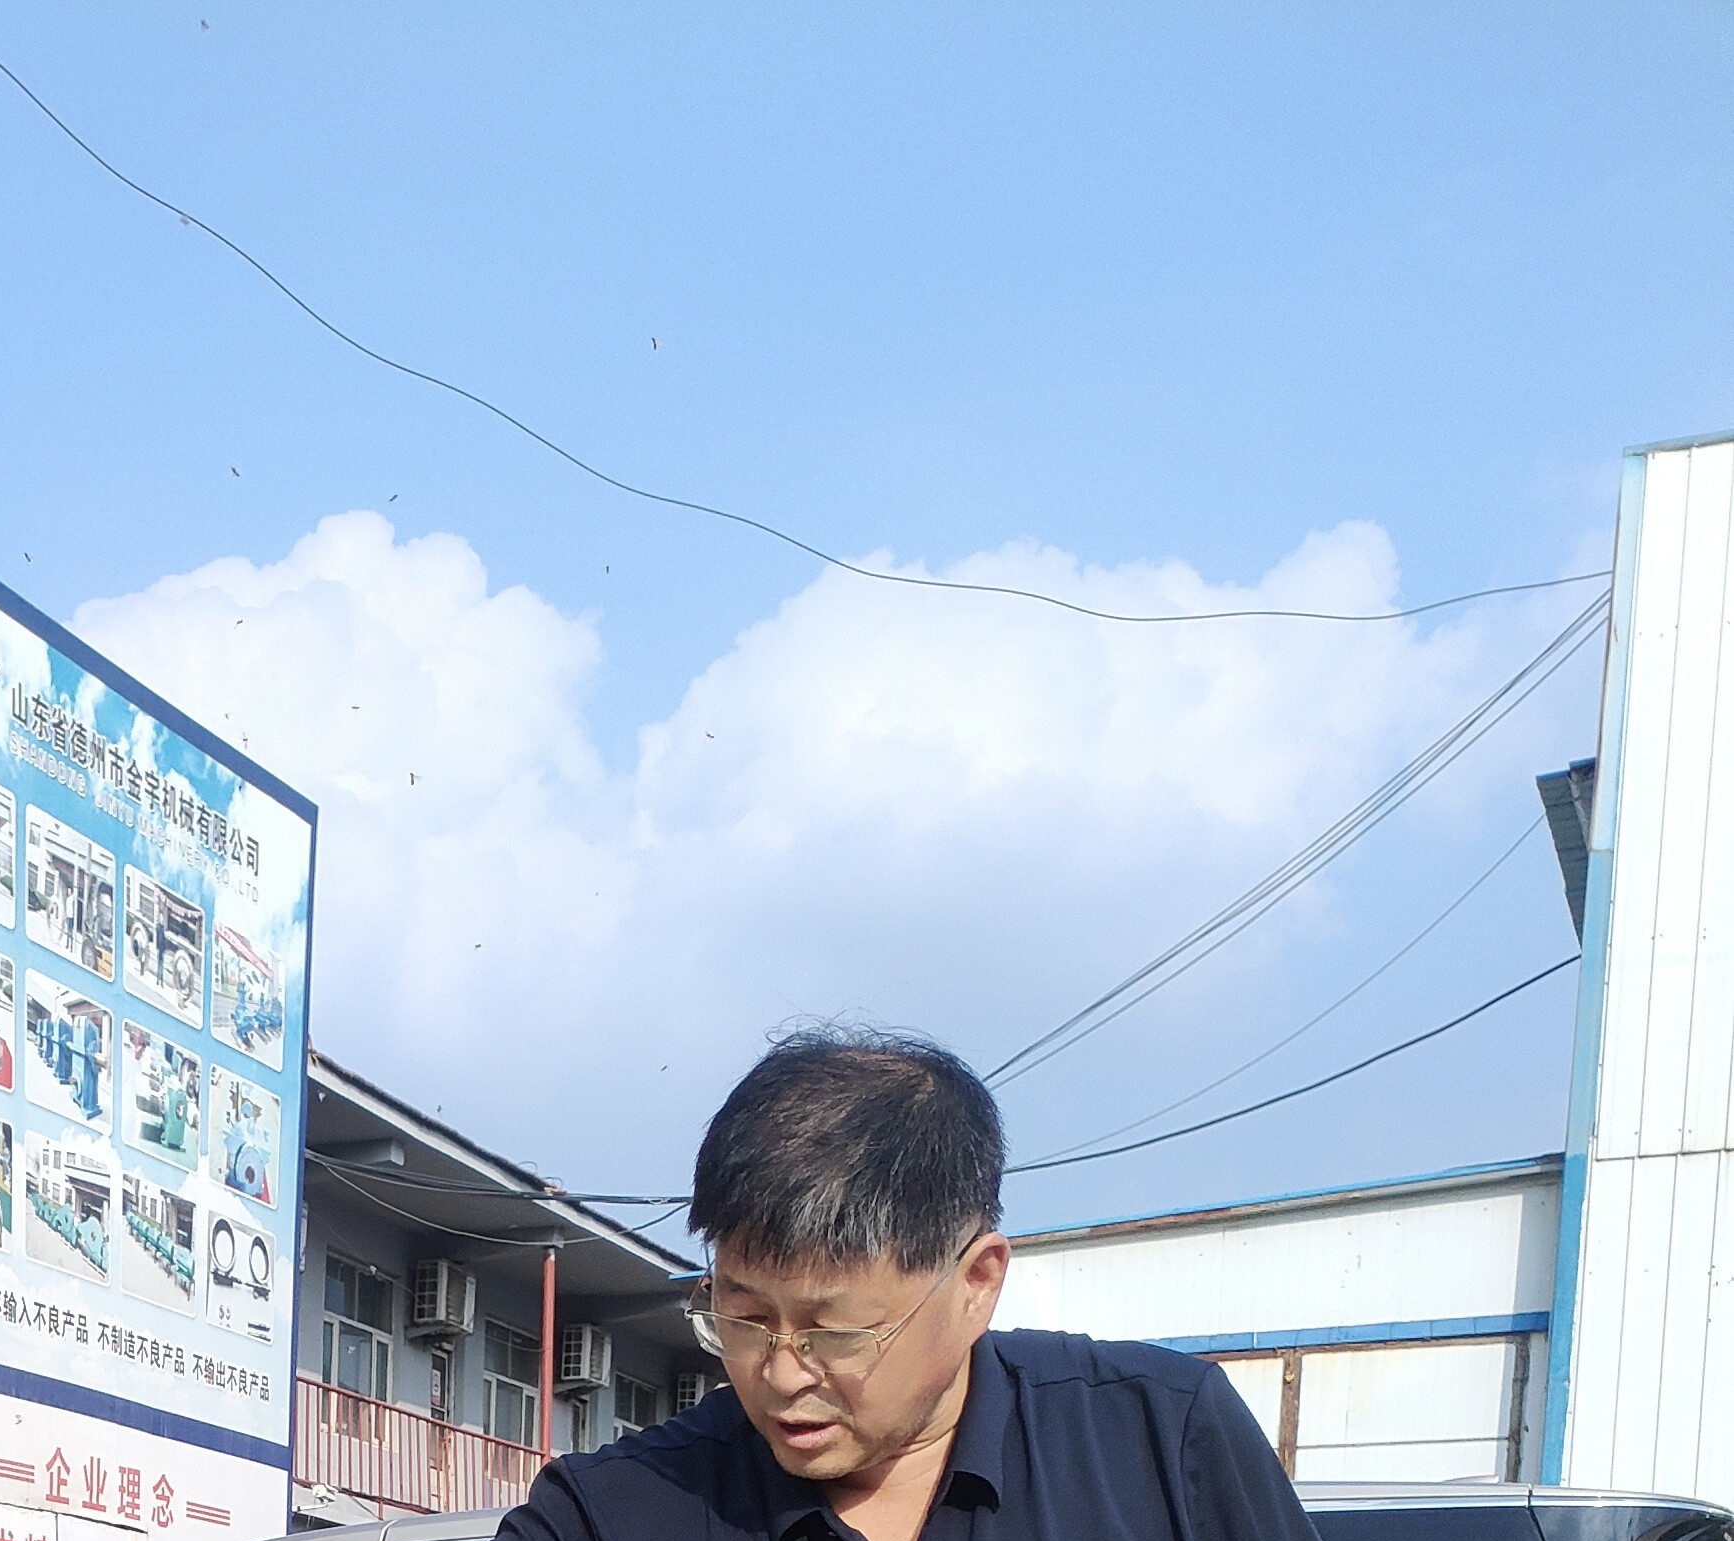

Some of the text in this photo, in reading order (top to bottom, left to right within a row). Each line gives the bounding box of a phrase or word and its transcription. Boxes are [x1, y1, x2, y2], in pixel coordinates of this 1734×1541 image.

[11, 681, 260, 877] 山东省德州市金宇机械有限公司
[97, 1321, 185, 1376] 不制造不良产品
[192, 1353, 270, 1402] 不输出不良产品
[45, 1447, 175, 1529] 企业理念
